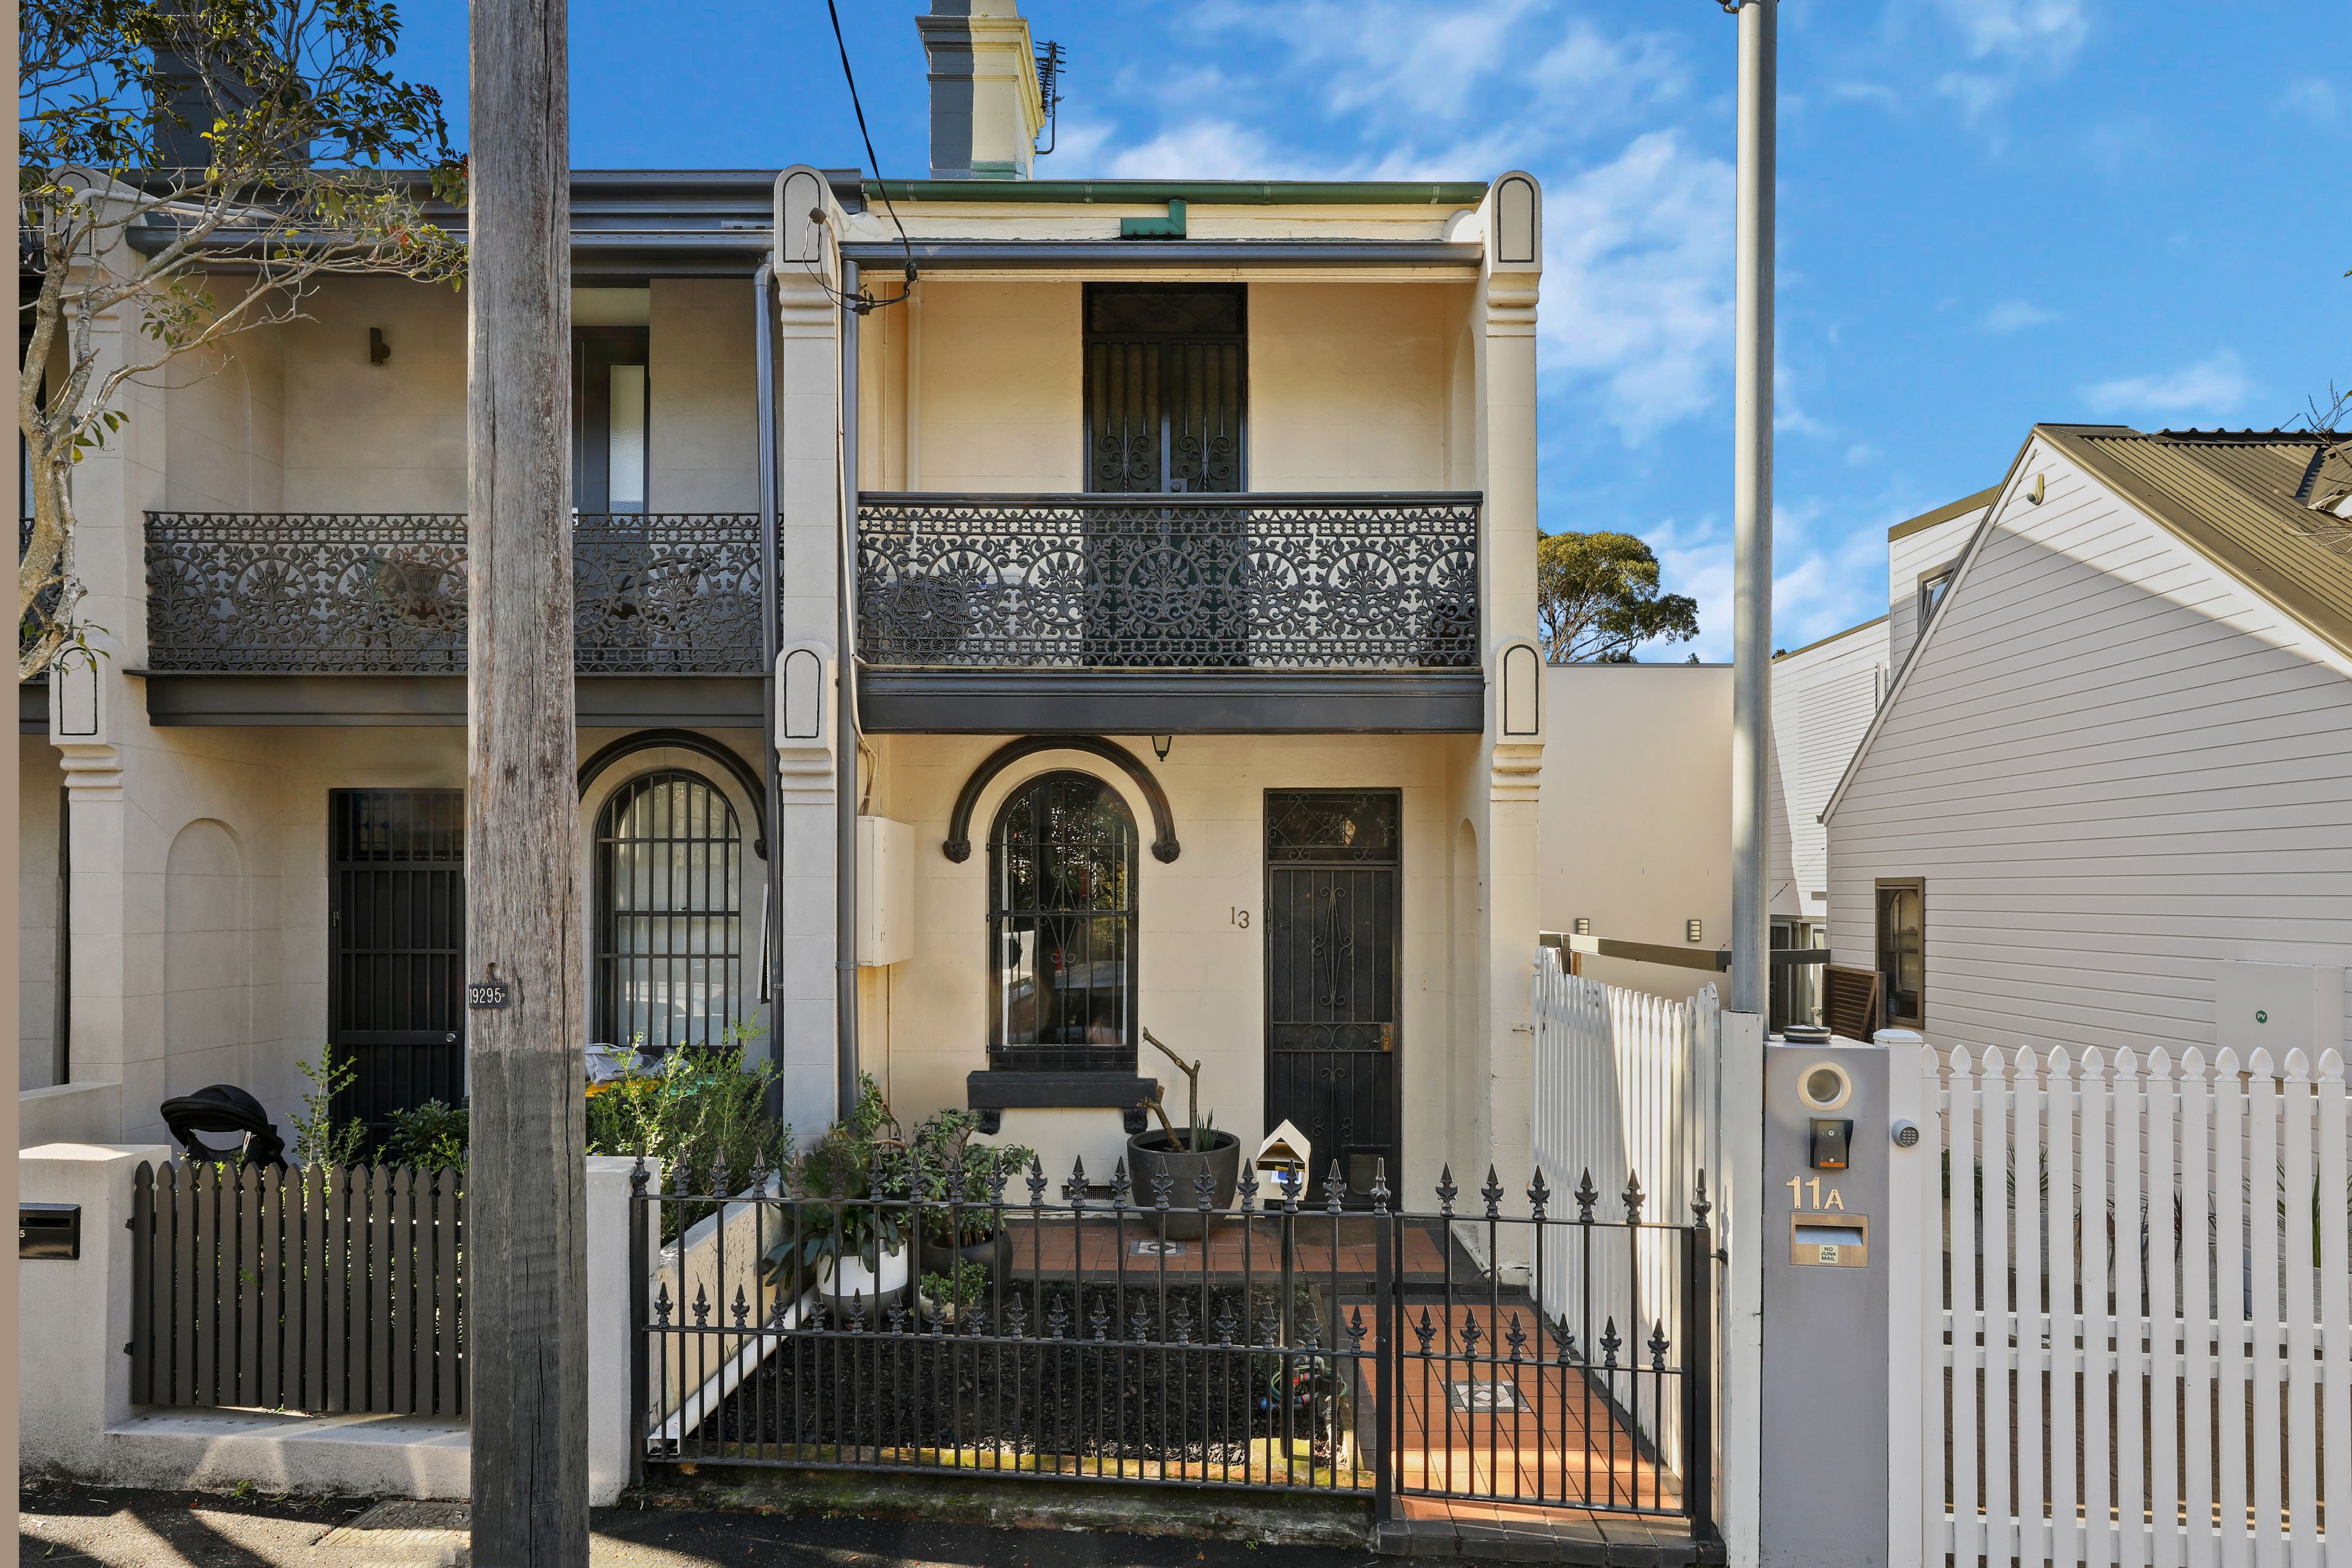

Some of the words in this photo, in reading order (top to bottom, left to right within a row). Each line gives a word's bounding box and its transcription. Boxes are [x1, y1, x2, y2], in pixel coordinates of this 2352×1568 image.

[1231, 906, 1250, 929] 13
[469, 987, 501, 1003] 19295
[1785, 1175, 1844, 1210] 11A
